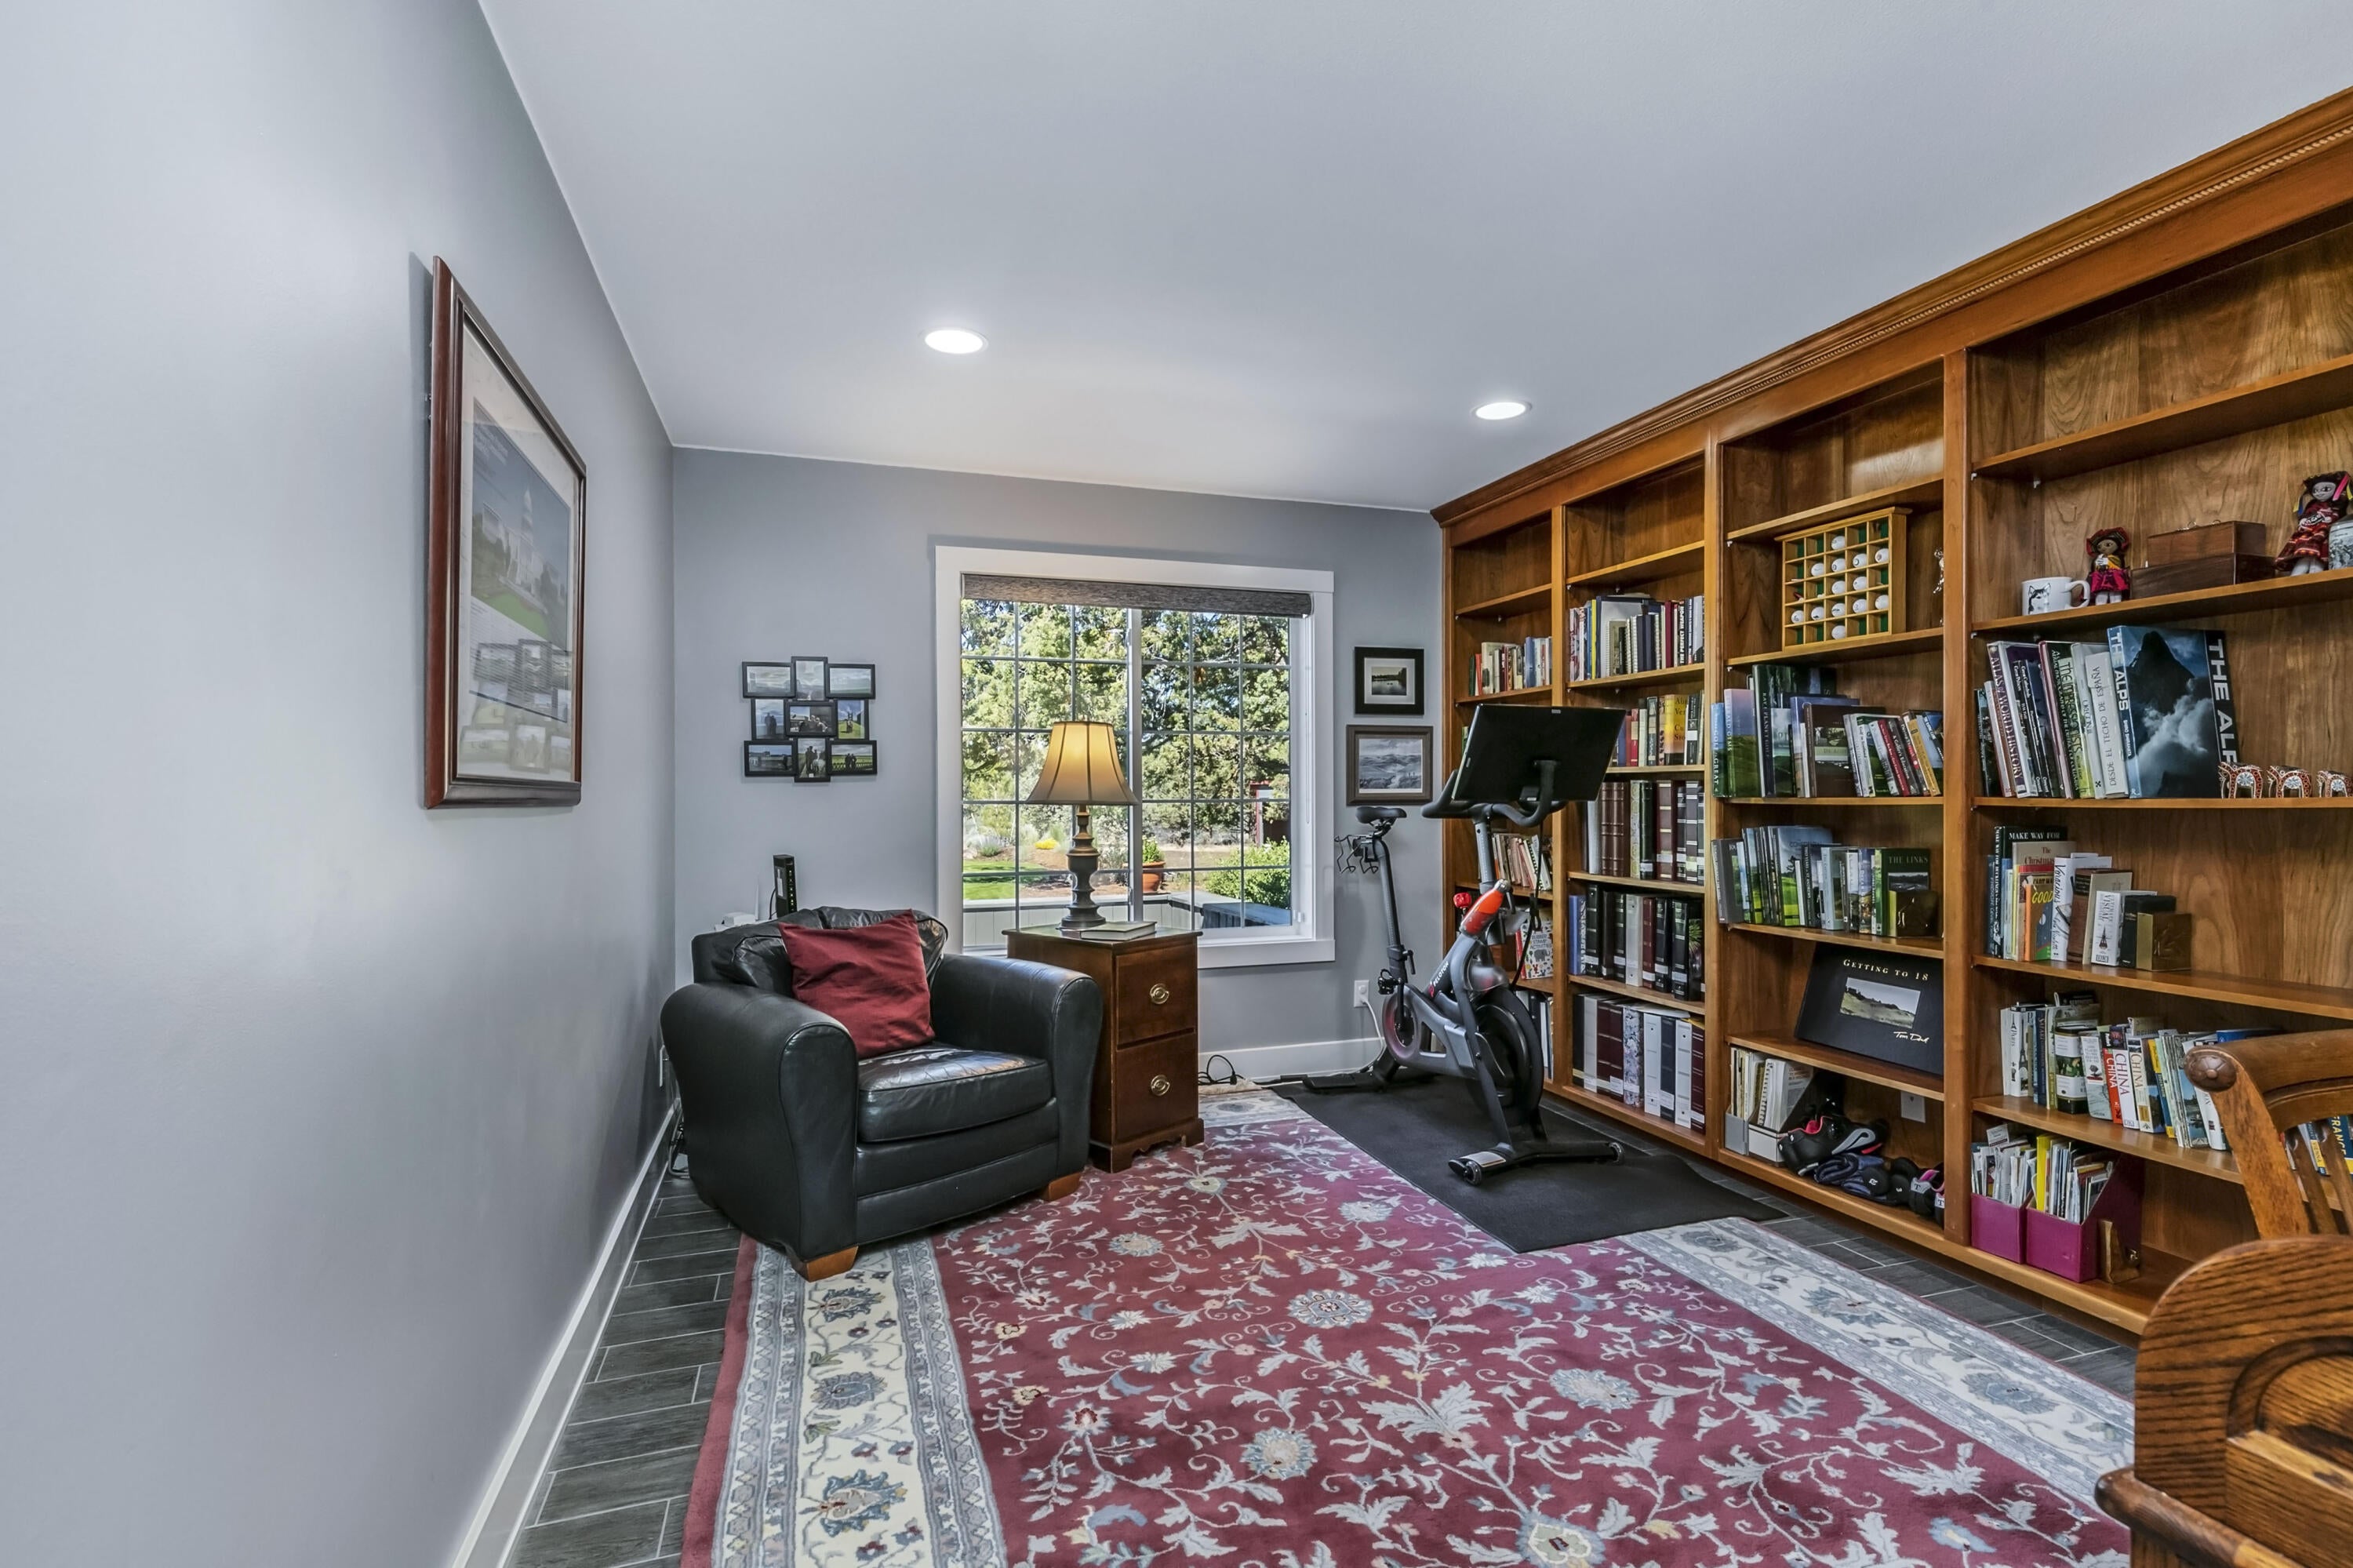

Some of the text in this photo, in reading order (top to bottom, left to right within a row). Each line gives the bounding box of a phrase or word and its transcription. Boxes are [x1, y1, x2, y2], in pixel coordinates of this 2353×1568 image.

[1991, 657, 2004, 686] ATLAS
[2209, 638, 2231, 700] THE
[2114, 670, 2129, 711] ALPS
[1997, 695, 2013, 733] WORLD
[2061, 682, 2083, 753] IMPRESSIONISTS
[2090, 666, 2117, 786] DESDE EL TECHO DE ESPAÑA
[1893, 740, 1903, 757] Golfer's
[2007, 735, 2023, 779] HISTORY
[2054, 864, 2066, 904] Voracious
[2101, 894, 2111, 922] VISUAL
[1433, 961, 1449, 987] PELOTON
[1842, 959, 1889, 974] GETTING
[1915, 972, 1929, 981] 18
[2106, 1057, 2117, 1088] CHINA
[2115, 1053, 2130, 1095] CHINA
[2130, 1053, 2144, 1088] CHINA
[2313, 1142, 2322, 1162] VIENNA
